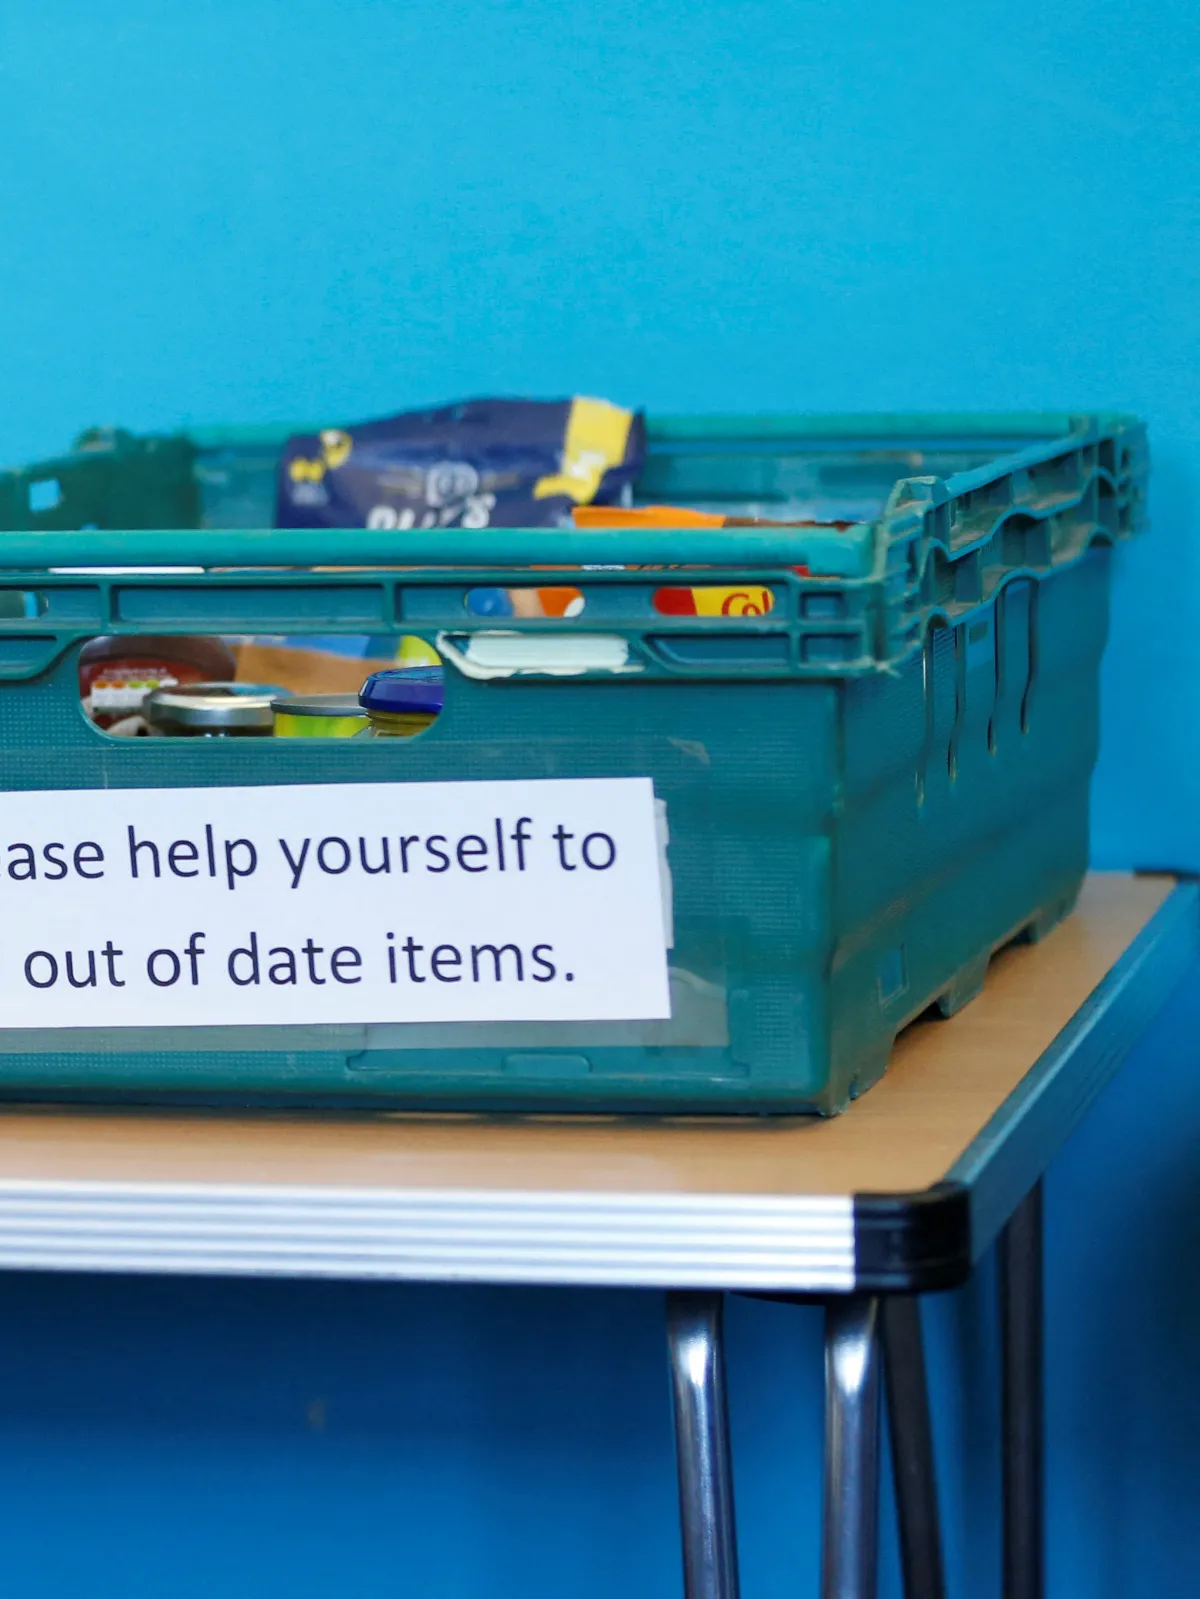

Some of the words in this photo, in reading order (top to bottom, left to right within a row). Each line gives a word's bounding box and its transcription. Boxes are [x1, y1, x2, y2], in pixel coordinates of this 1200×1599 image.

[127, 824, 258, 891] help
[278, 817, 533, 890] yourself
[552, 825, 617, 877] to
[25, 941, 126, 989] out
[146, 932, 206, 987] of
[228, 932, 363, 986] date
[386, 932, 574, 984] items.
